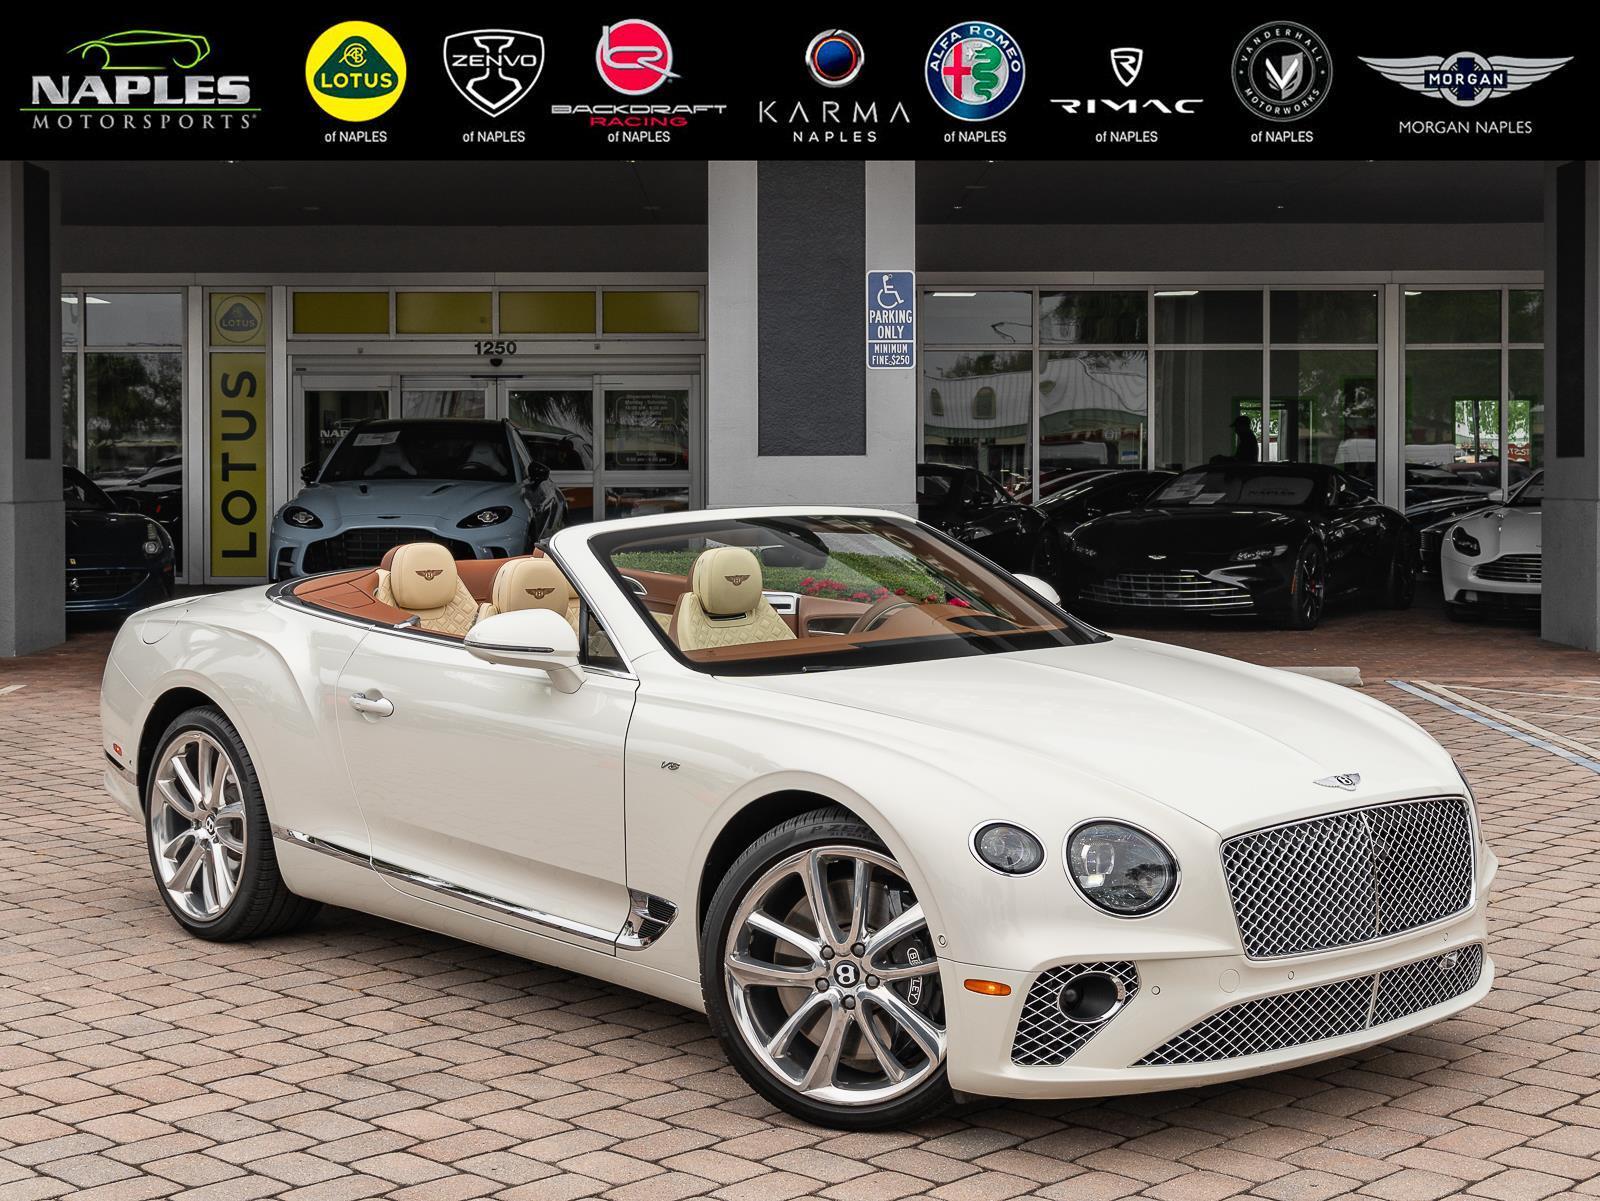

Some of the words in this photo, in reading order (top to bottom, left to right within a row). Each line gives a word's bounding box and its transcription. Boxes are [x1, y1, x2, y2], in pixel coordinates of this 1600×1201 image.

[222, 319, 256, 328] LOTUS
[869, 309, 913, 324] PARKING
[877, 325, 905, 340] ONLY
[474, 340, 517, 356] 1250
[874, 343, 908, 354] MINIMUM
[872, 355, 889, 365] FINE
[891, 354, 910, 366] $250
[220, 370, 258, 559] LOTUS
